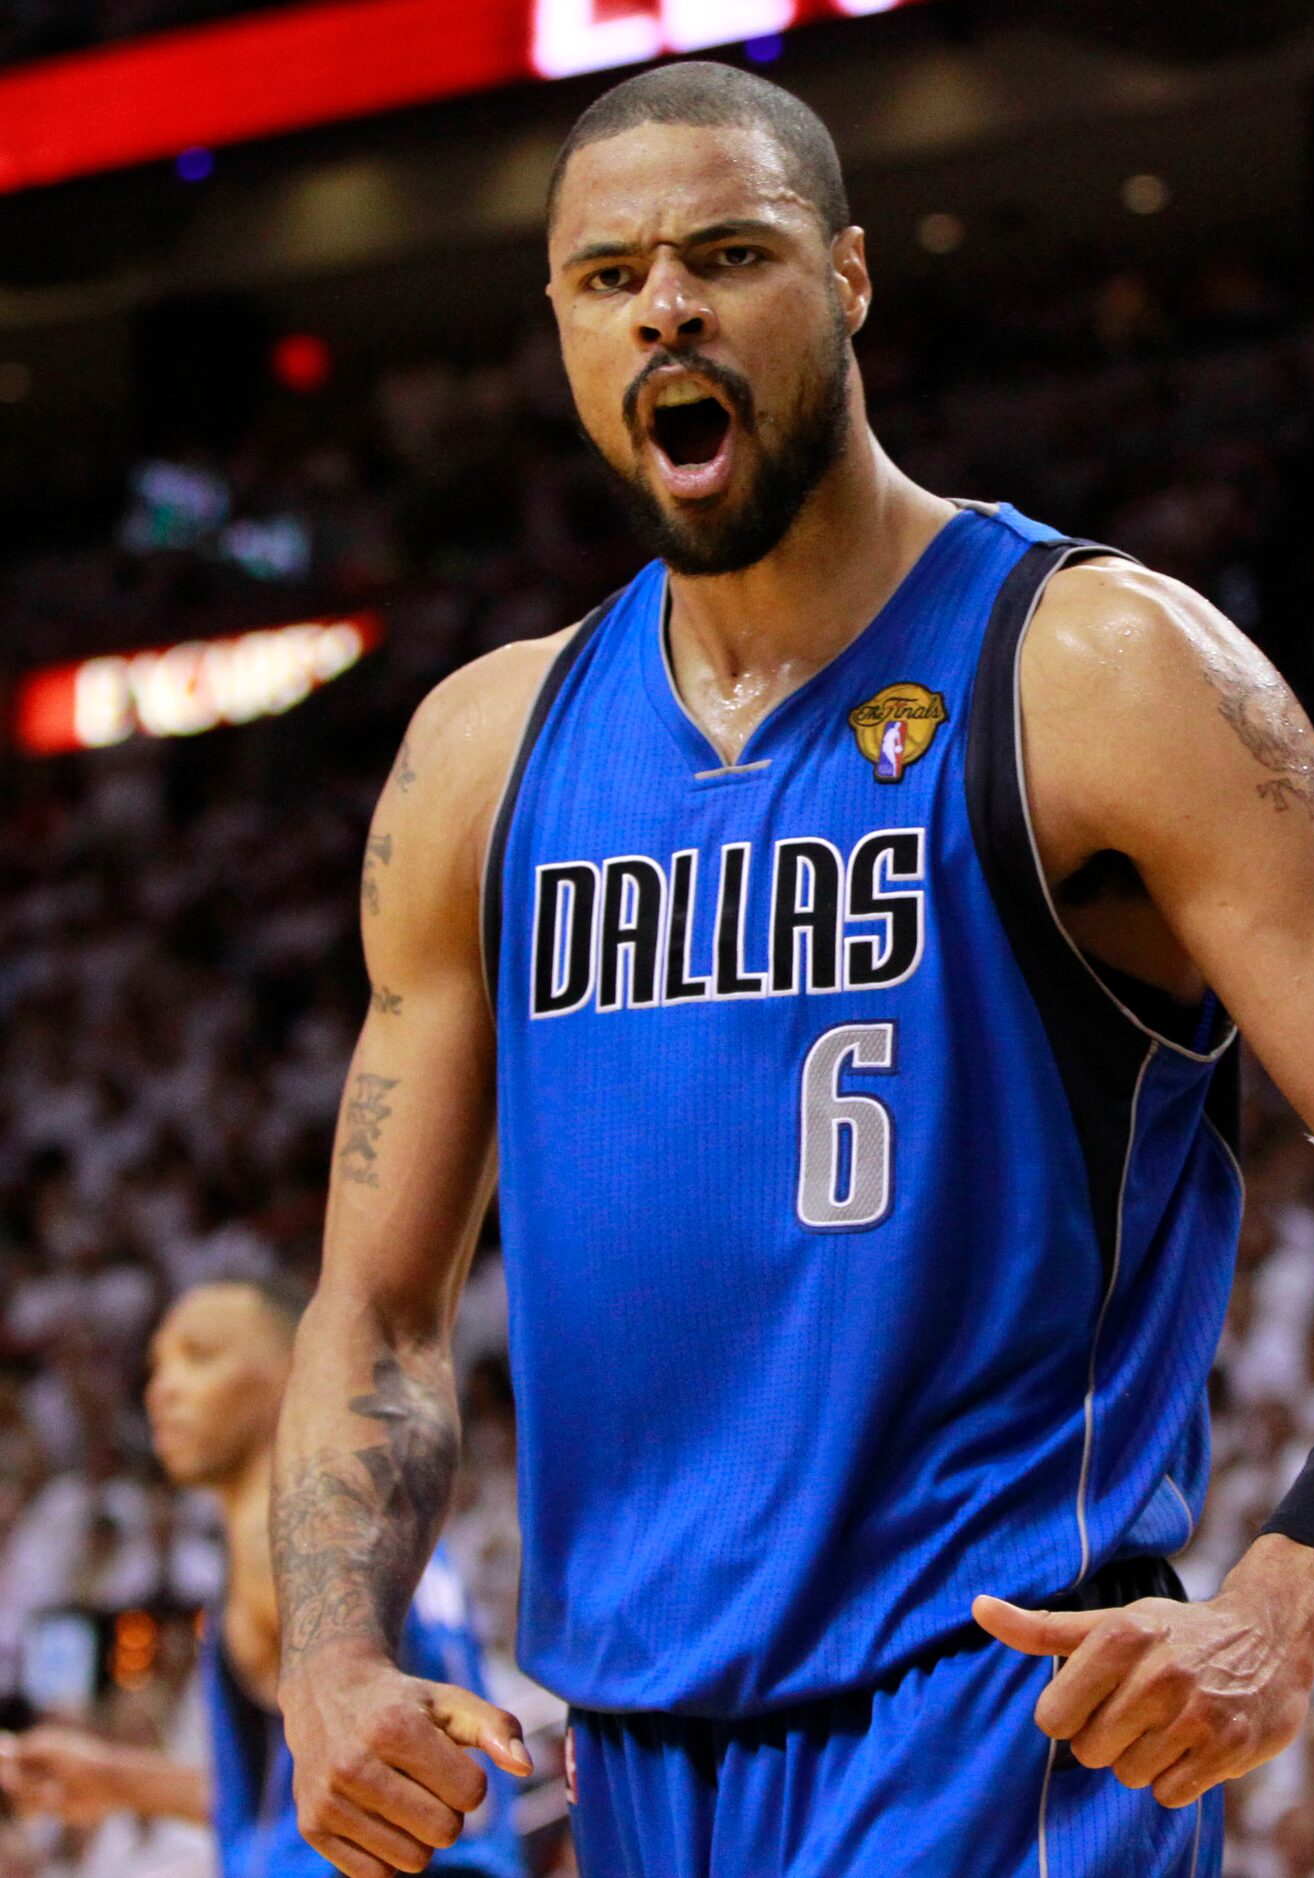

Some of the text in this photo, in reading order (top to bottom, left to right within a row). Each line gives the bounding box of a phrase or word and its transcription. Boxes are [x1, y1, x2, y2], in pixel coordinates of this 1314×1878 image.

[882, 696, 941, 721] Finals
[530, 827, 925, 1020] DALLAS
[797, 1021, 896, 1230] 6
